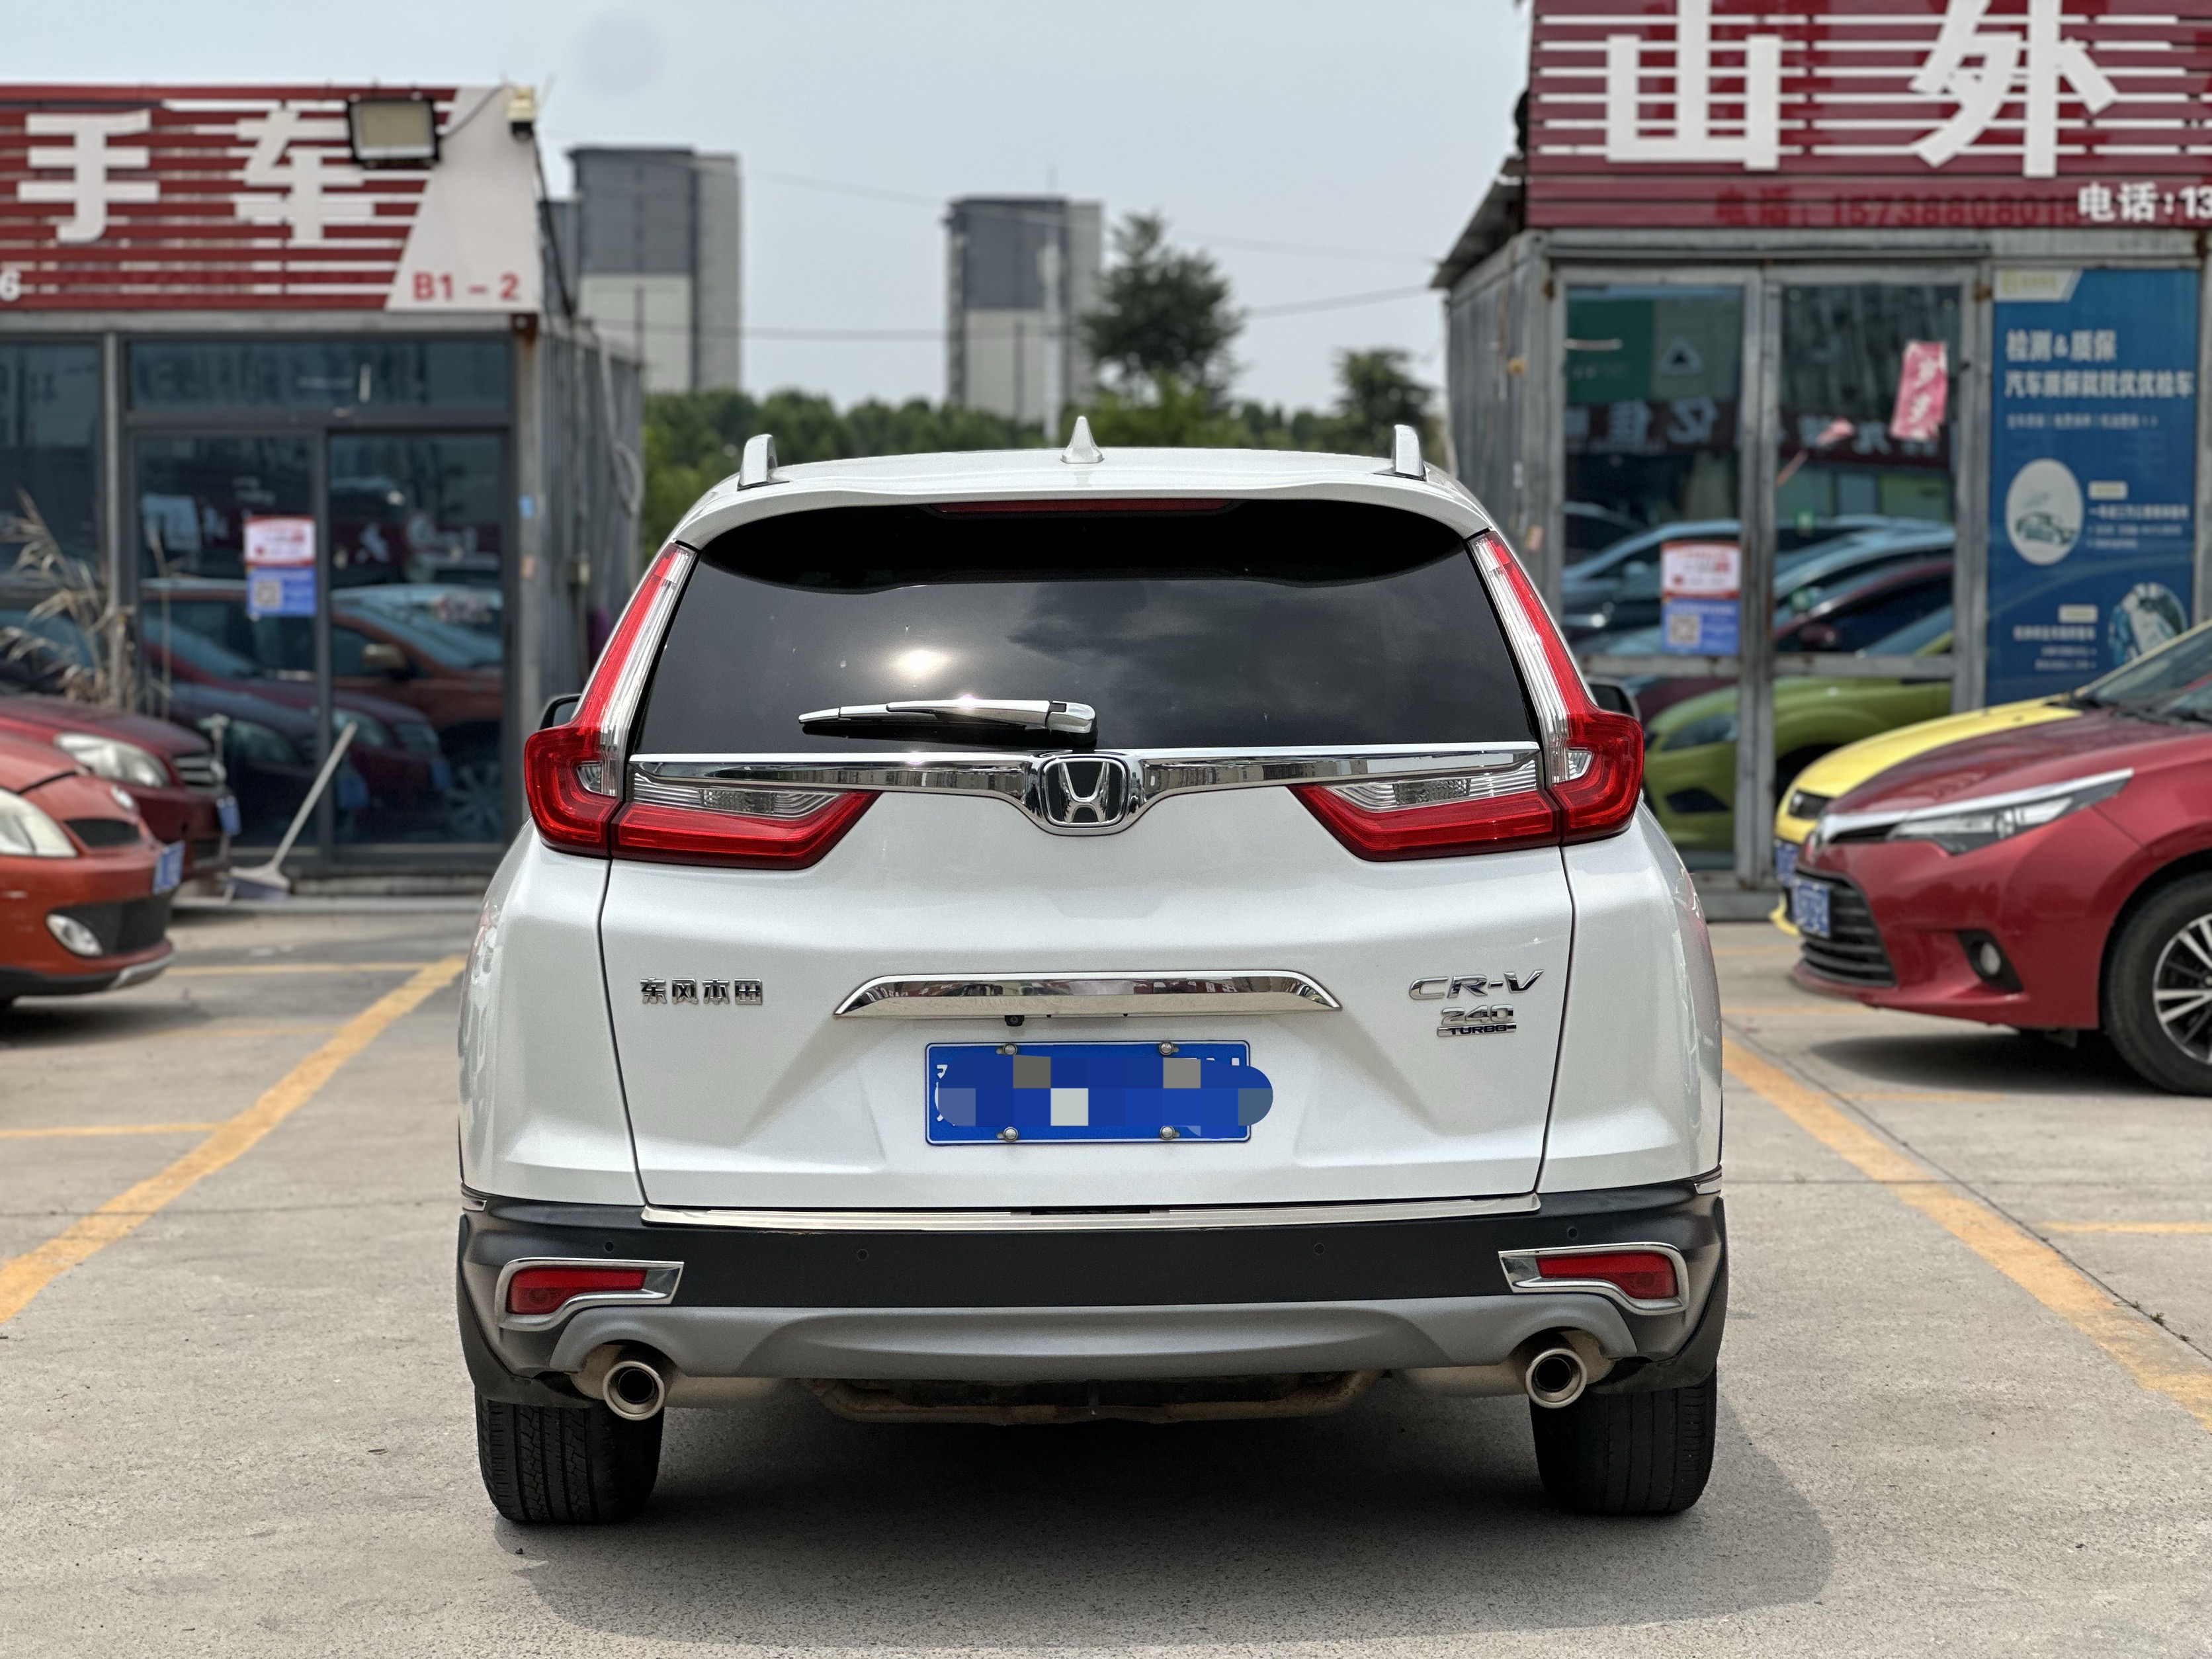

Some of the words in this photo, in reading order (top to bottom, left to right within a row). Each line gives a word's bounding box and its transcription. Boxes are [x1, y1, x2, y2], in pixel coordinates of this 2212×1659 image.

[640, 977, 763, 1005] 东风本田
[1408, 968, 1545, 1000] CR-V
[1441, 1003, 1514, 1025] 240
[1444, 1023, 1511, 1036] TURBO
